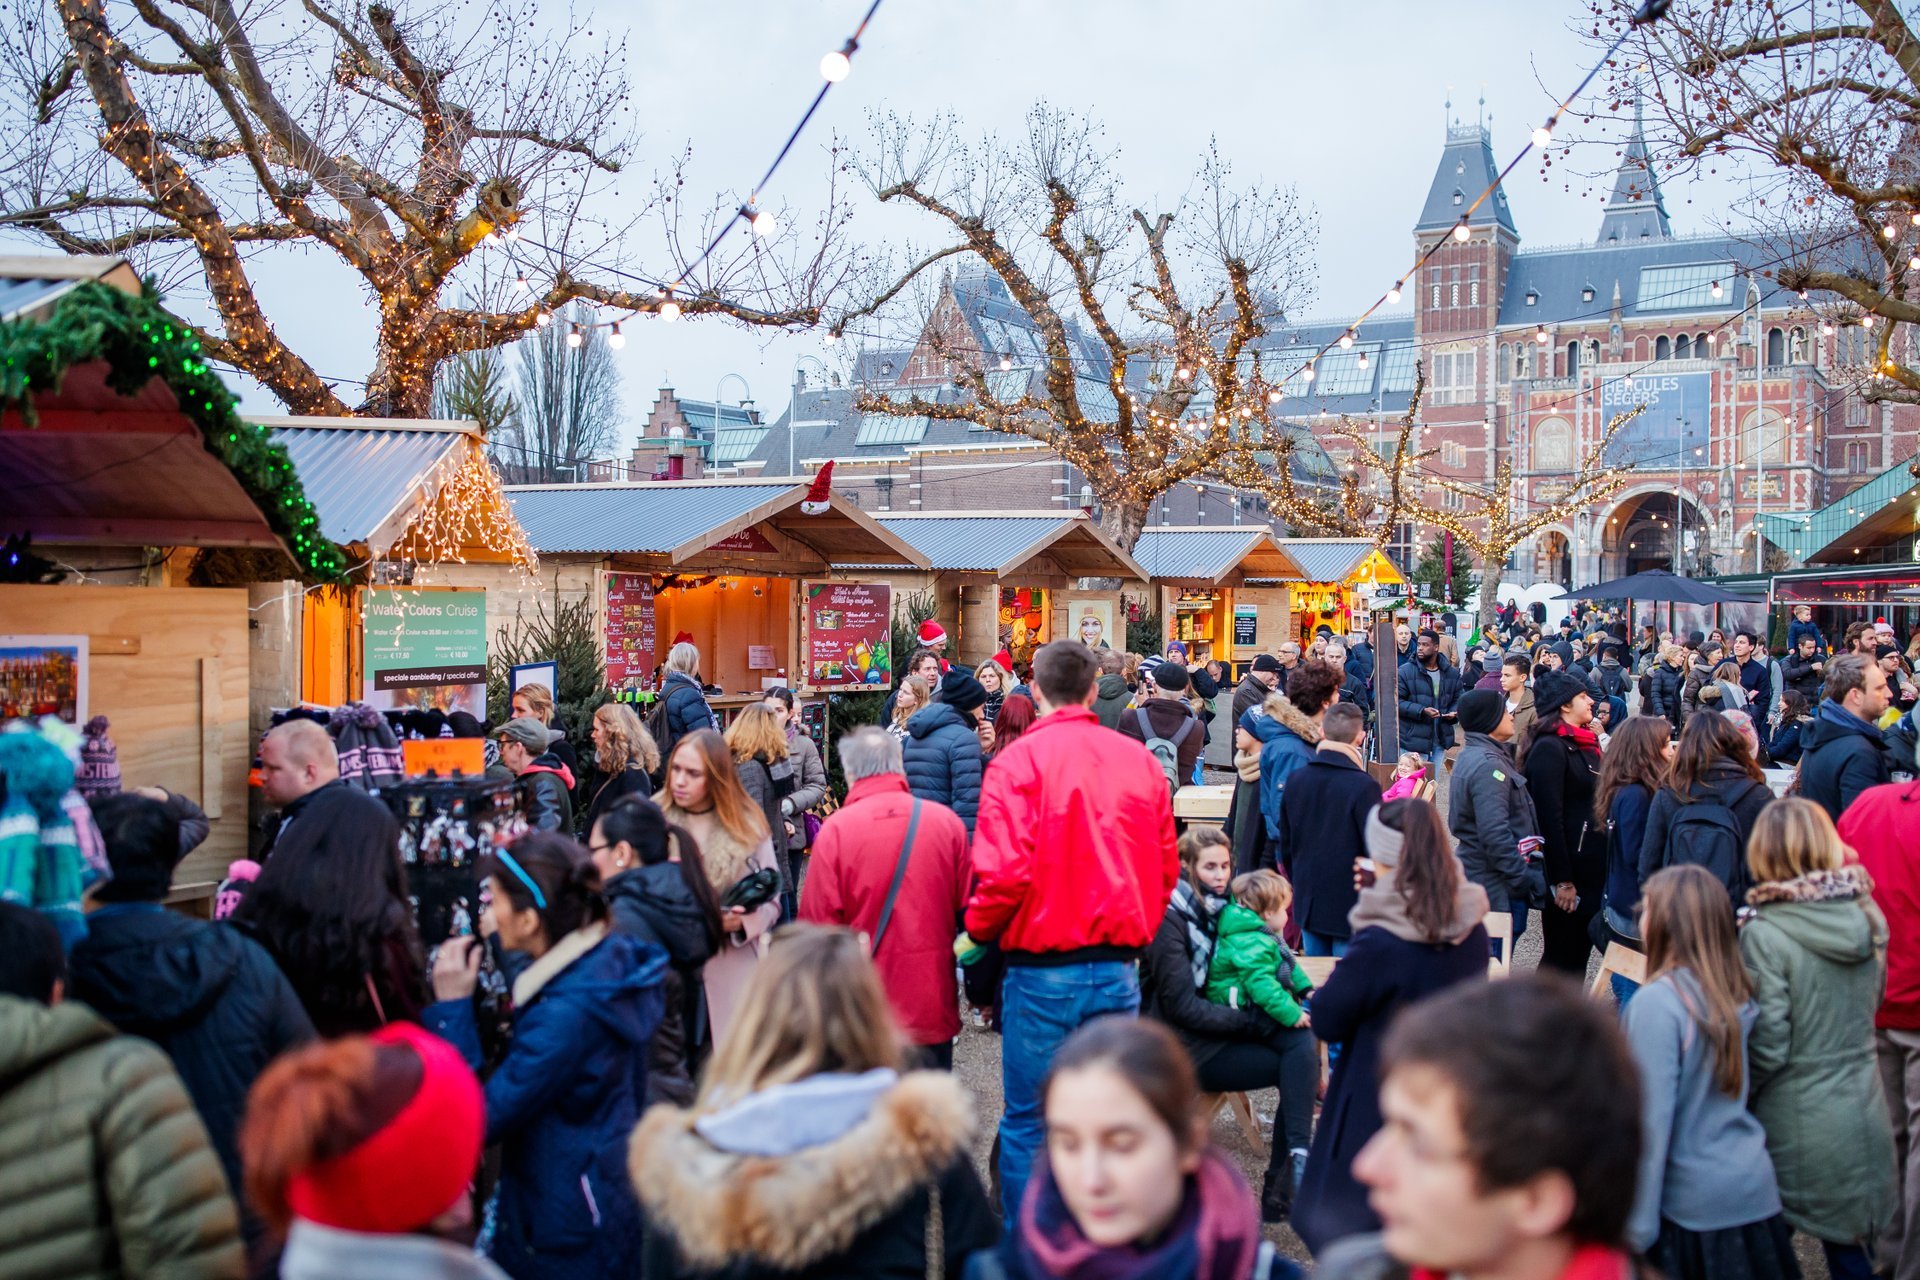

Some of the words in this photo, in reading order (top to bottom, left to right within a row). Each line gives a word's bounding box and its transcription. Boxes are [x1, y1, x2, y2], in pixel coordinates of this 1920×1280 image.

[1604, 377, 1679, 393] HERCULES
[1604, 391, 1660, 406] SEGERS
[372, 604, 404, 616] Water
[408, 604, 442, 616] Colors
[446, 603, 478, 616] Cruise
[383, 674, 409, 682] speciale
[409, 673, 442, 681] aanbieding
[446, 672, 466, 680] special
[466, 671, 480, 679] offer
